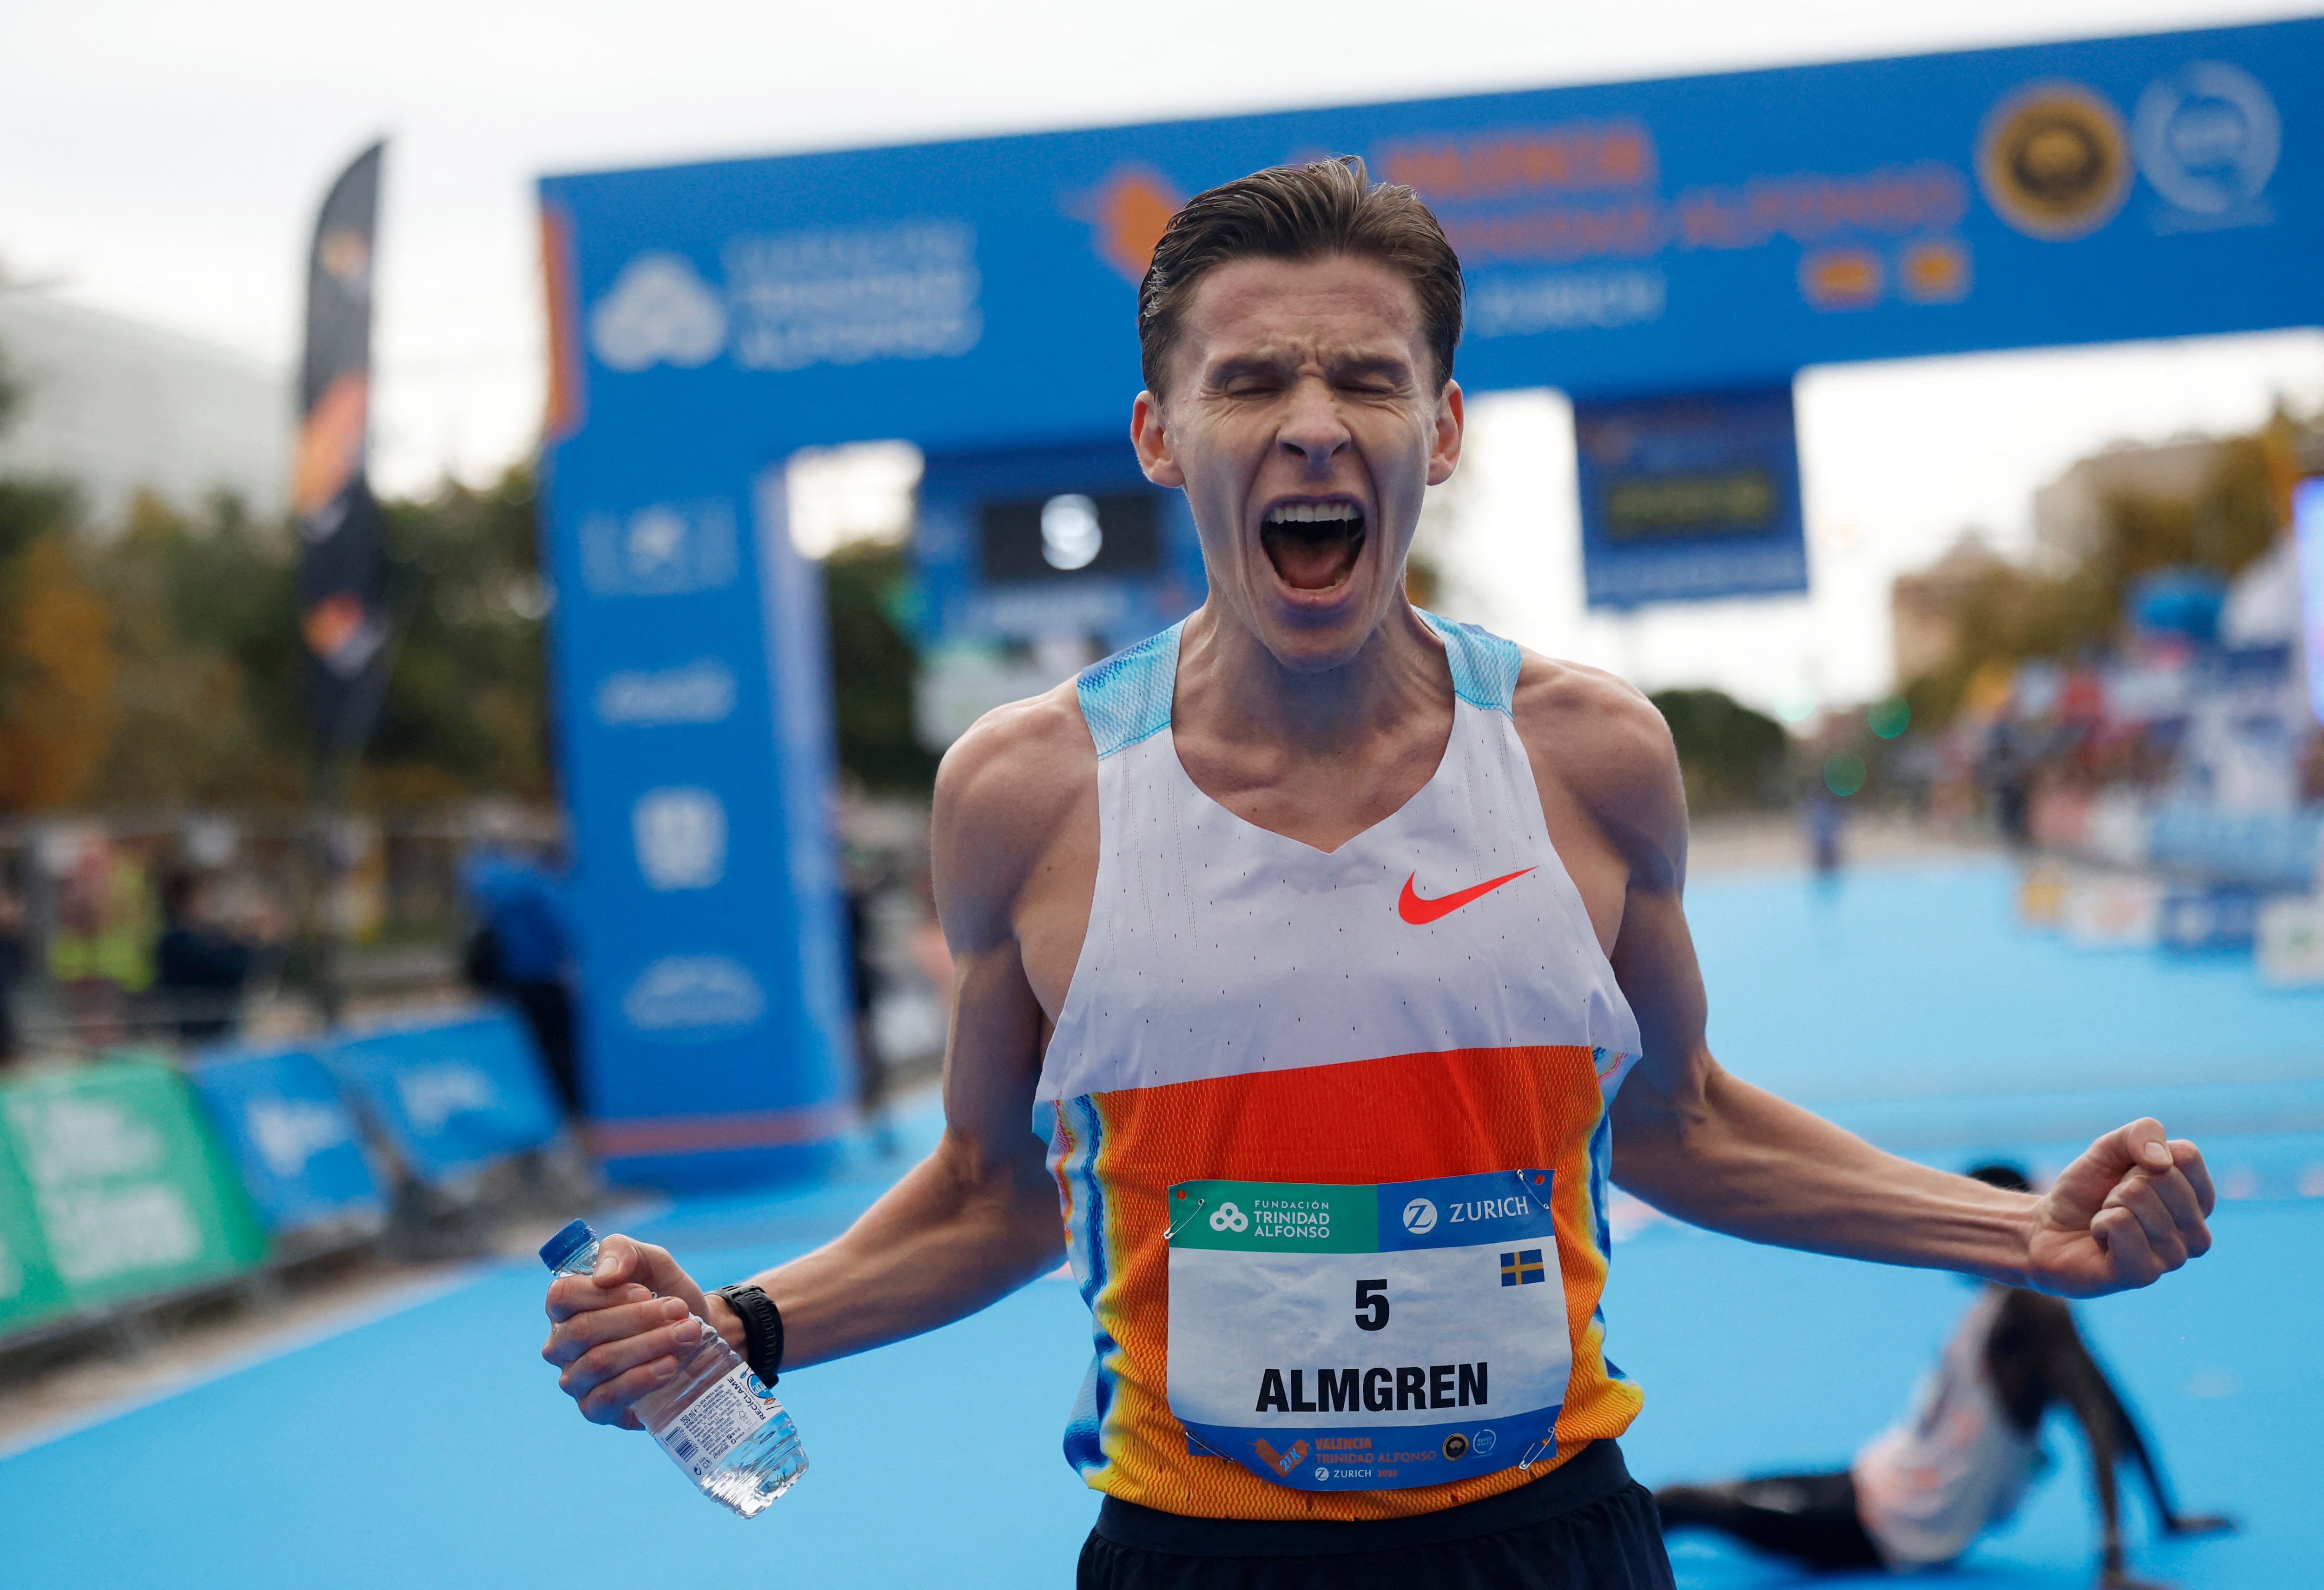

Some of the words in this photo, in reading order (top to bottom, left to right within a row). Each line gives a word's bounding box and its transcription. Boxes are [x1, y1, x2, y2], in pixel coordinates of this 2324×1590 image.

[1254, 1200, 1329, 1210] FUNDACIÓN
[1449, 1196, 1530, 1223] ZURICH
[1254, 1211, 1330, 1225] TRINIDAD
[1254, 1225, 1330, 1239] ALFONSO
[1354, 1279, 1390, 1332] 5
[1255, 1361, 1488, 1412] ALMGREN
[727, 1376, 766, 1420] RECÍCLAME
[680, 1414, 691, 1425] 350
[687, 1409, 696, 1419] ml
[1314, 1437, 1373, 1450] VALENCIA
[1279, 1447, 1302, 1472] 21K
[1314, 1453, 1374, 1464] TRINIDAD
[1377, 1450, 1437, 1463] ALFONSO
[1334, 1469, 1372, 1478] ZURICH
